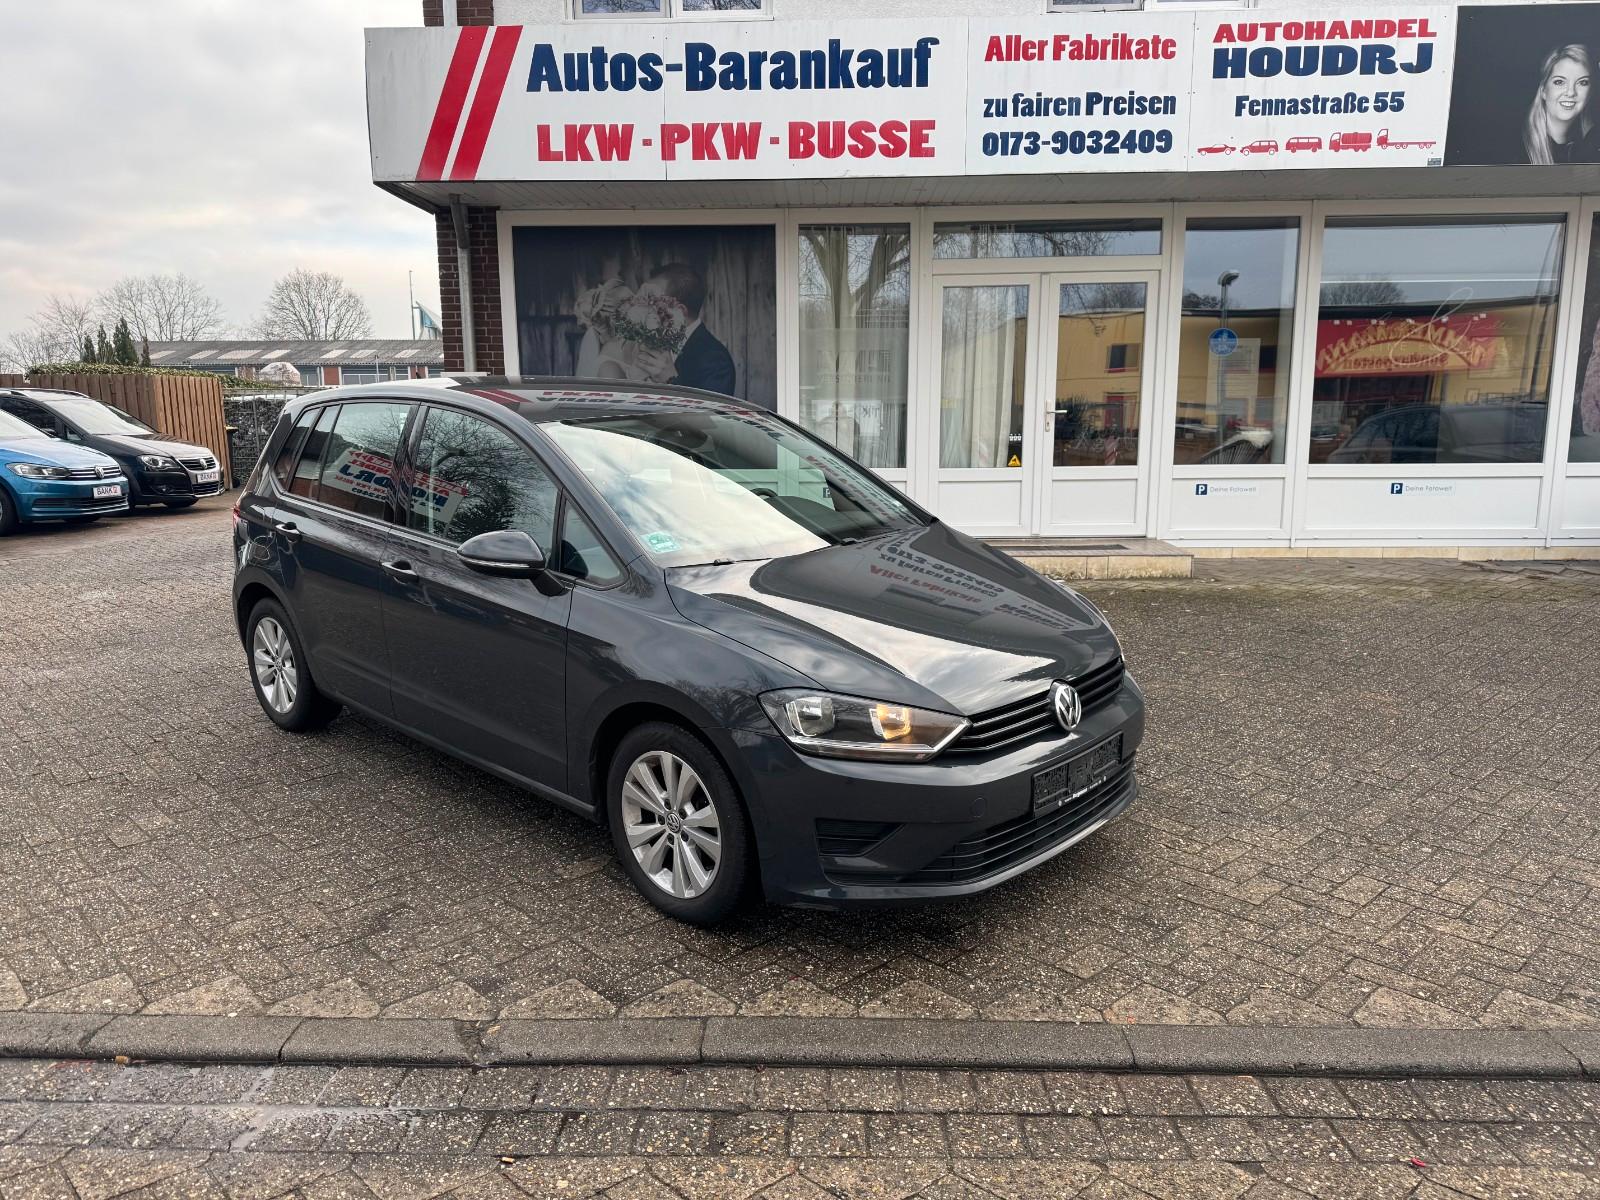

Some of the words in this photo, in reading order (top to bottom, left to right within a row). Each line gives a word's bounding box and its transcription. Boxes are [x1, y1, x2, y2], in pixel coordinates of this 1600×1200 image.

[1213, 18, 1437, 43] AUTOHANDEL
[984, 34, 1048, 63] Aller
[1052, 33, 1177, 62] Fabrikate
[1212, 43, 1434, 79] HOUDRJ
[526, 37, 940, 93] Autos-Barankauf
[983, 98, 1008, 118] zu
[1011, 92, 1082, 118] fairen
[1085, 91, 1177, 116] Preisen
[1234, 92, 1370, 117] Fennastraße
[1373, 91, 1406, 113] 55
[537, 123, 634, 162] LKW
[660, 121, 762, 161] PKW
[787, 119, 937, 159] BUSSE
[982, 129, 1173, 157] 0173-9032409
